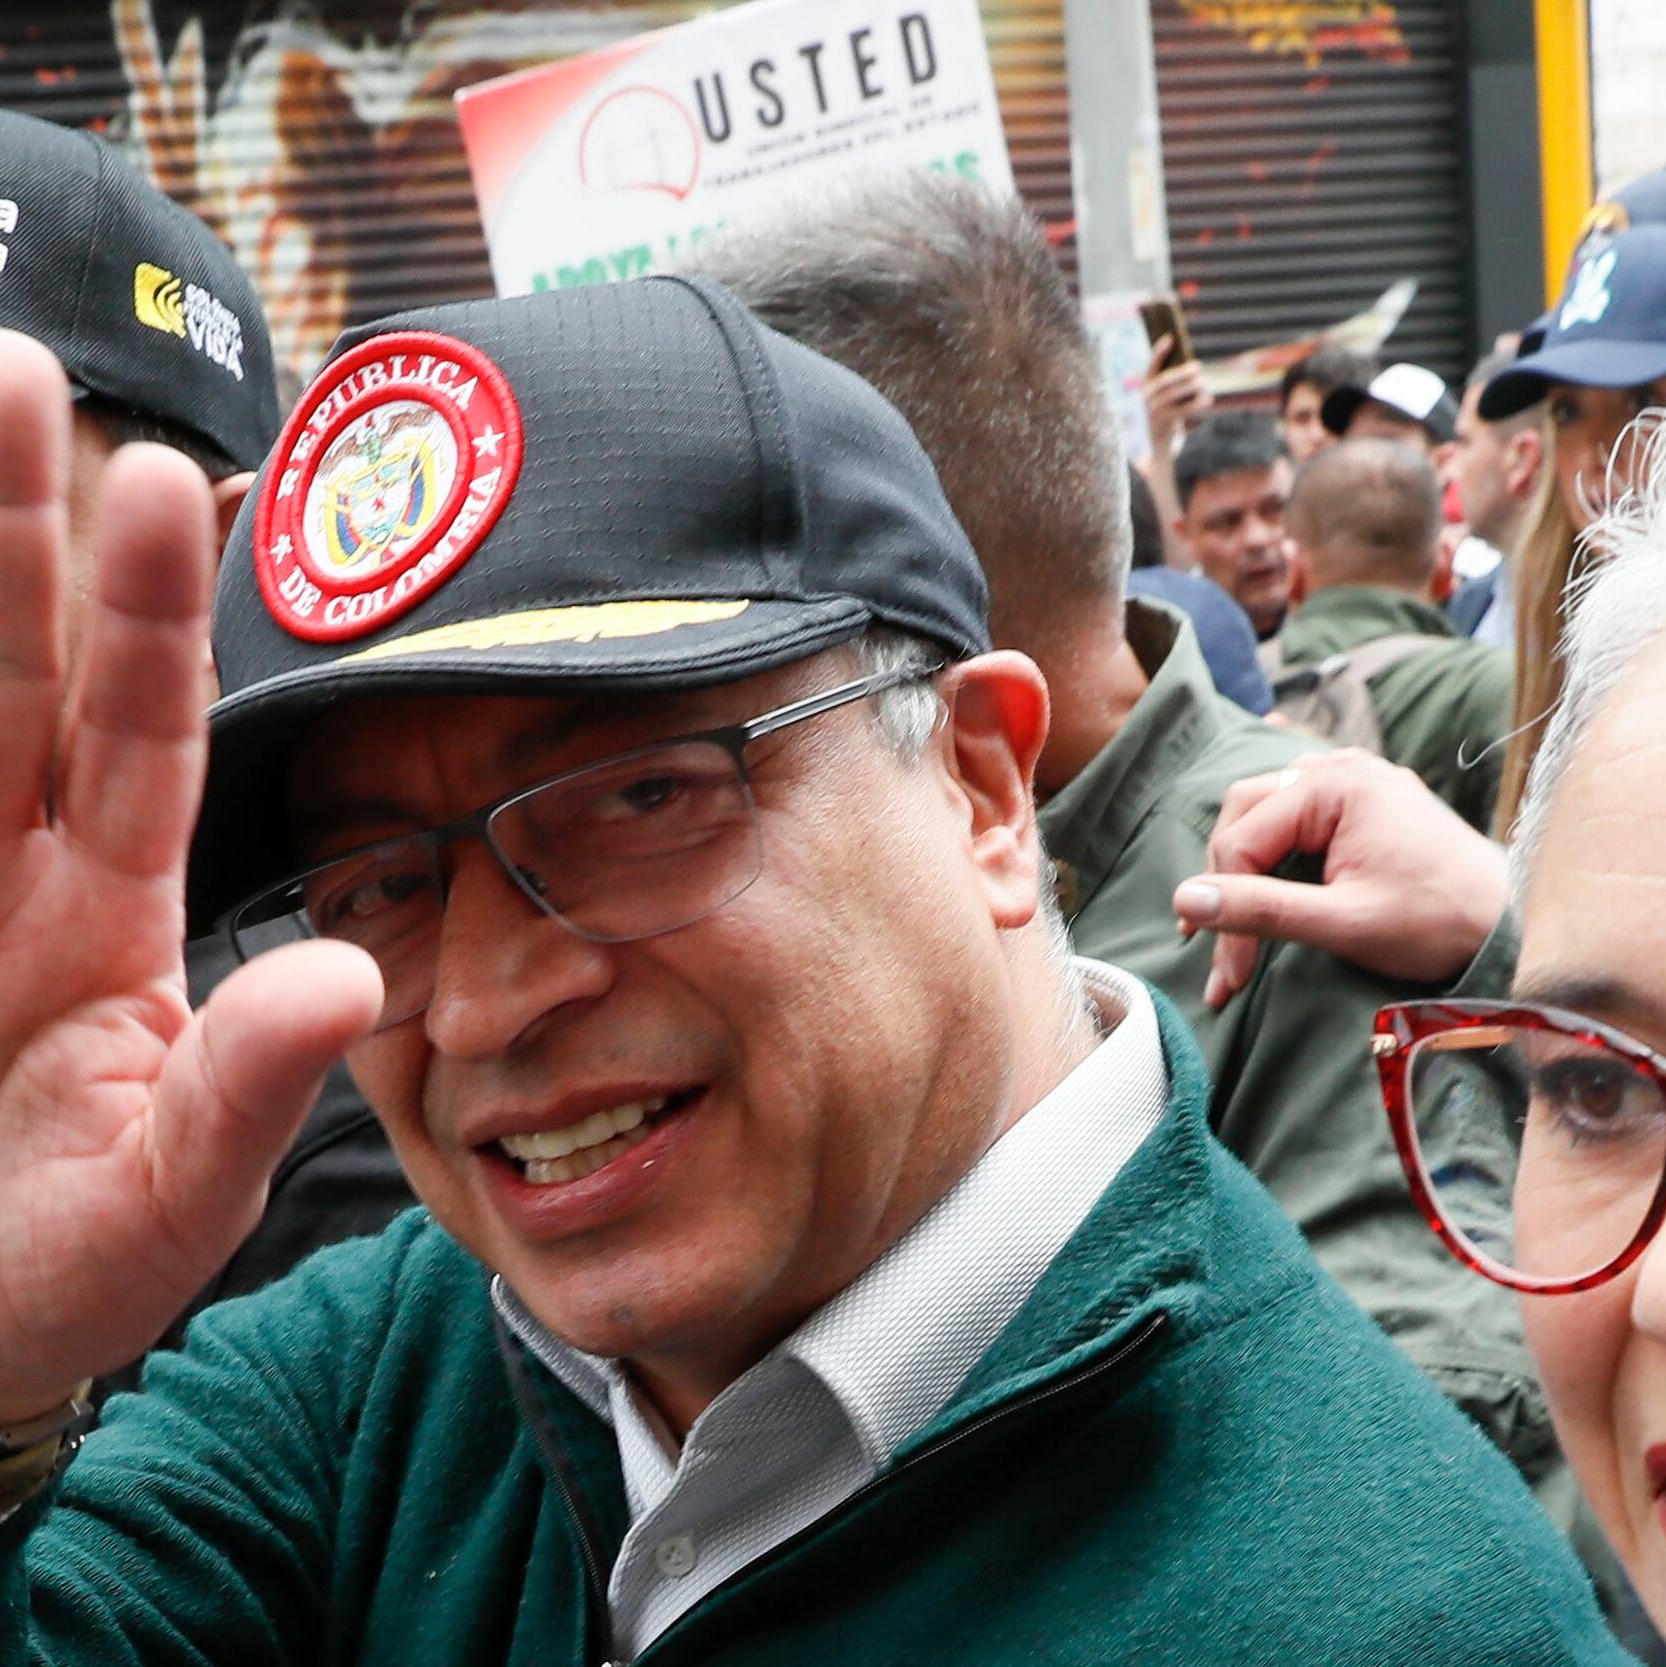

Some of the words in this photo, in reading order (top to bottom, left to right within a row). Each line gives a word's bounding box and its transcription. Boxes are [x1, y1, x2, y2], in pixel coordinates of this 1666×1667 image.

[693, 12, 939, 145] USTED
[275, 354, 479, 500] REPUBLICA
[277, 564, 323, 618] DE
[322, 466, 502, 626] COLOMBIA
